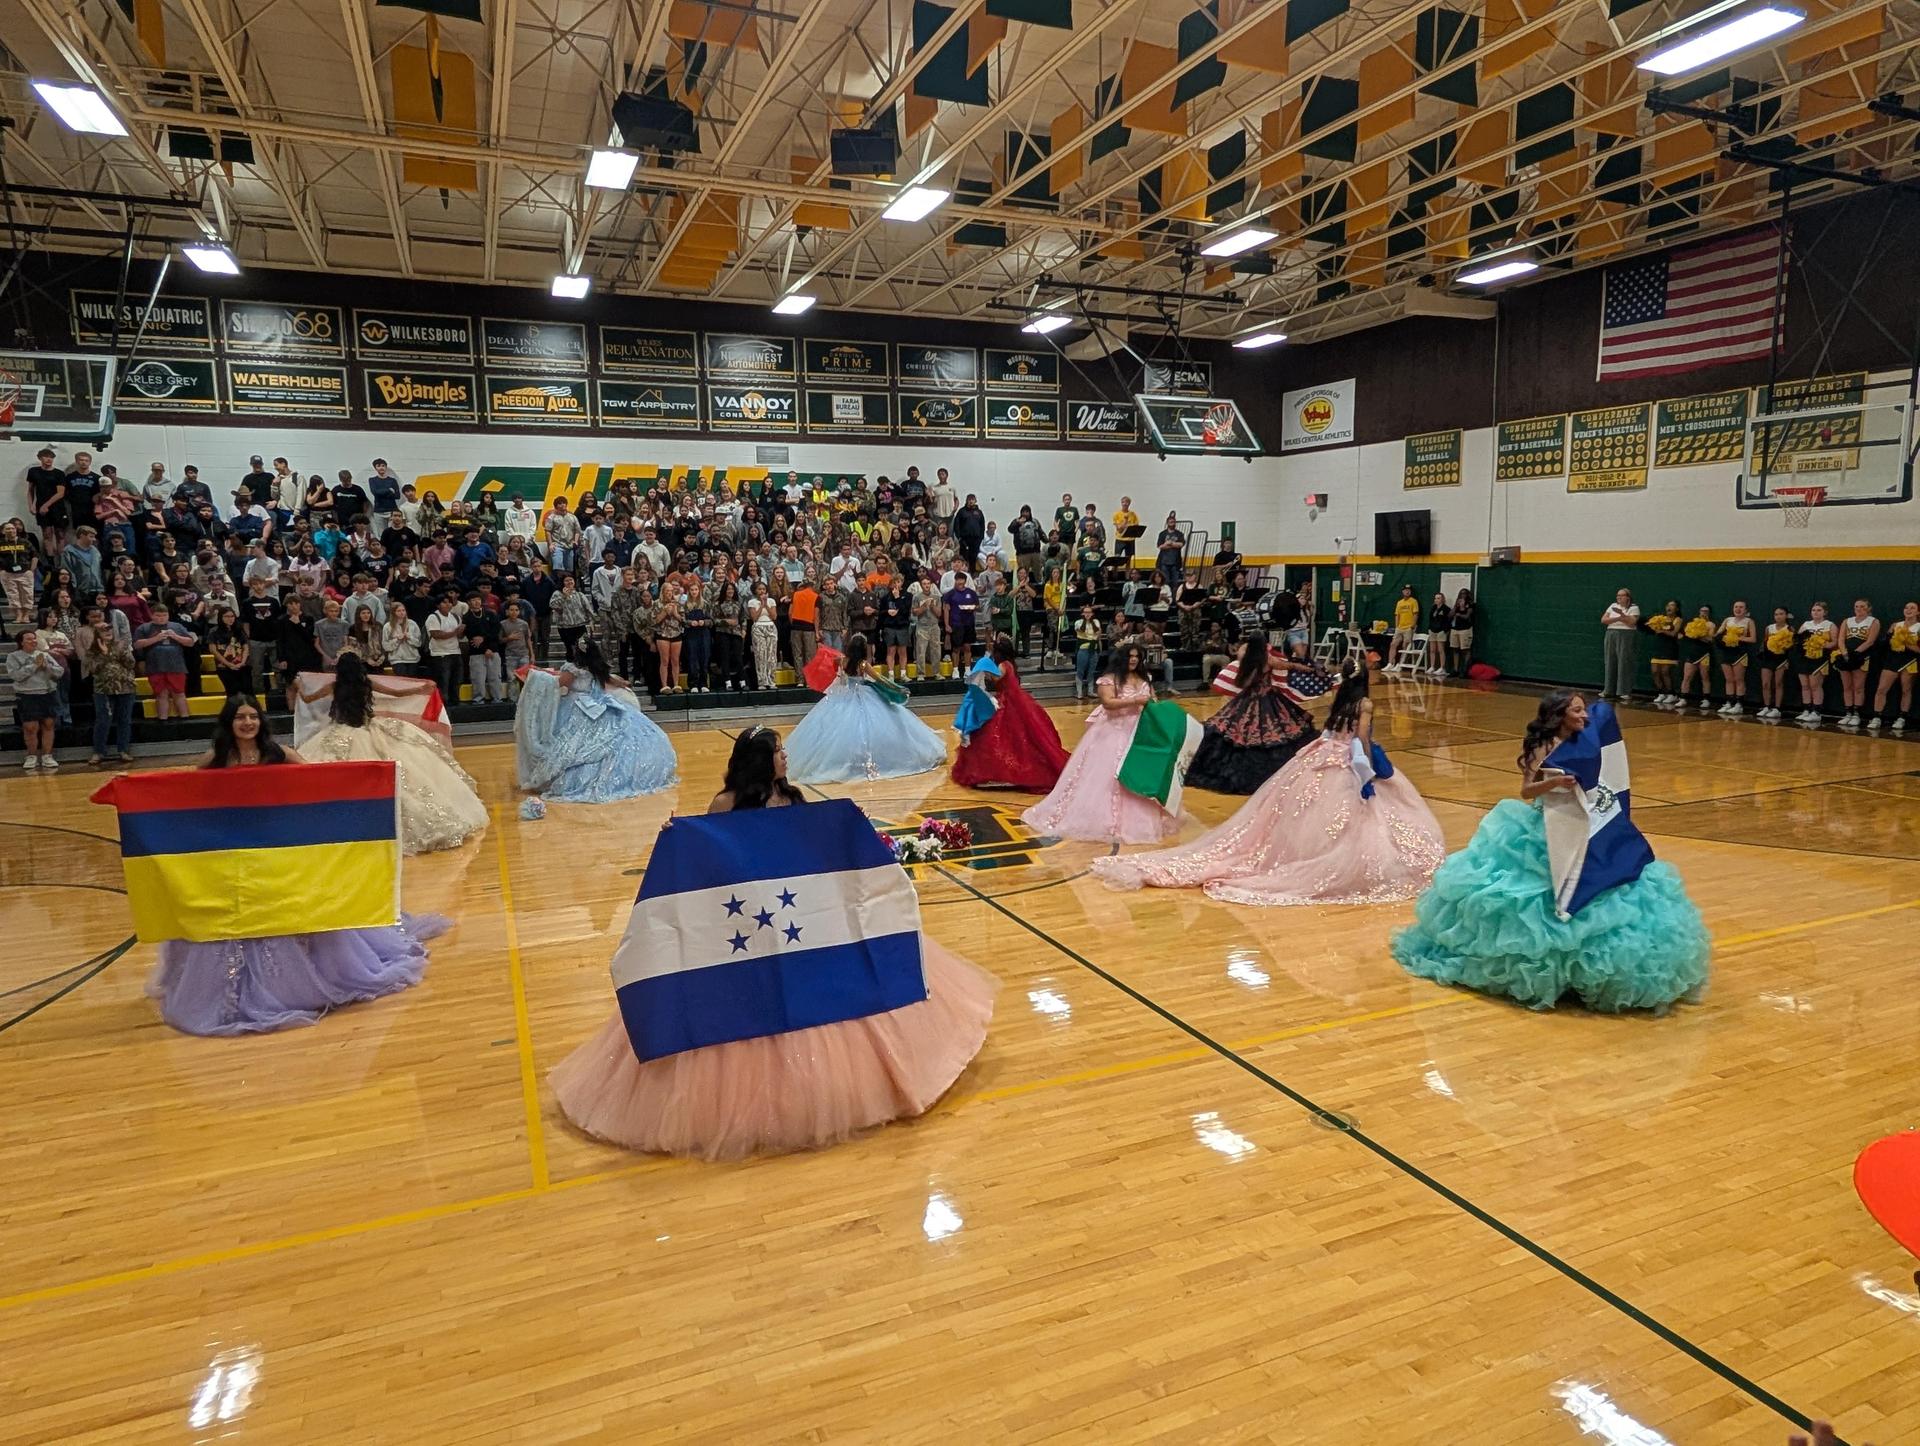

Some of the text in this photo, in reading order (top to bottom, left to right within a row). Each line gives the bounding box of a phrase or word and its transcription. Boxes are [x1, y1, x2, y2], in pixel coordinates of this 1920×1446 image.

[80, 303, 131, 320] WILKS
[119, 320, 171, 331] CLNIC
[390, 325, 466, 343] WILKESBORO
[488, 336, 580, 350] DEAL INSUCE
[605, 344, 694, 359] REJUVENATION
[721, 351, 783, 363] NOHWEST
[727, 361, 777, 370] AUTOMOTIVE
[822, 356, 872, 369] PRIME
[117, 375, 198, 386] ARLES GREY
[233, 372, 342, 389] WATERHOUSE
[375, 376, 467, 404] Bojangles
[1771, 380, 1852, 398] ONFRENCE
[493, 393, 578, 411] FREEDOM AUTO
[631, 401, 696, 410] CARPENTRY
[714, 396, 793, 410] VANNOY
[1667, 395, 1738, 413] CONFERENCE
[720, 411, 788, 420] CONSTRUCTION
[1031, 413, 1050, 421] Smiles
[1581, 407, 1641, 422] CONFERENCE
[1674, 406, 1733, 422] CHAMPIONS
[1505, 420, 1558, 434] CONFERENCE
[1587, 416, 1636, 428] CHAMPIONS
[1659, 416, 1741, 434] MEN'S CROSSCOUNTRY
[1284, 430, 1351, 446] WILKES CENTRAL ATHLETICS
[1510, 430, 1554, 441] CHAMPIONS
[1574, 424, 1647, 438] WOMEN'S BASKETBALL
[1411, 433, 1455, 446] CONFERENCE
[1499, 438, 1562, 452] MEN'S BASKETBALL
[1416, 452, 1449, 462] BASEBALL
[1797, 461, 1843, 470] UNNER-U
